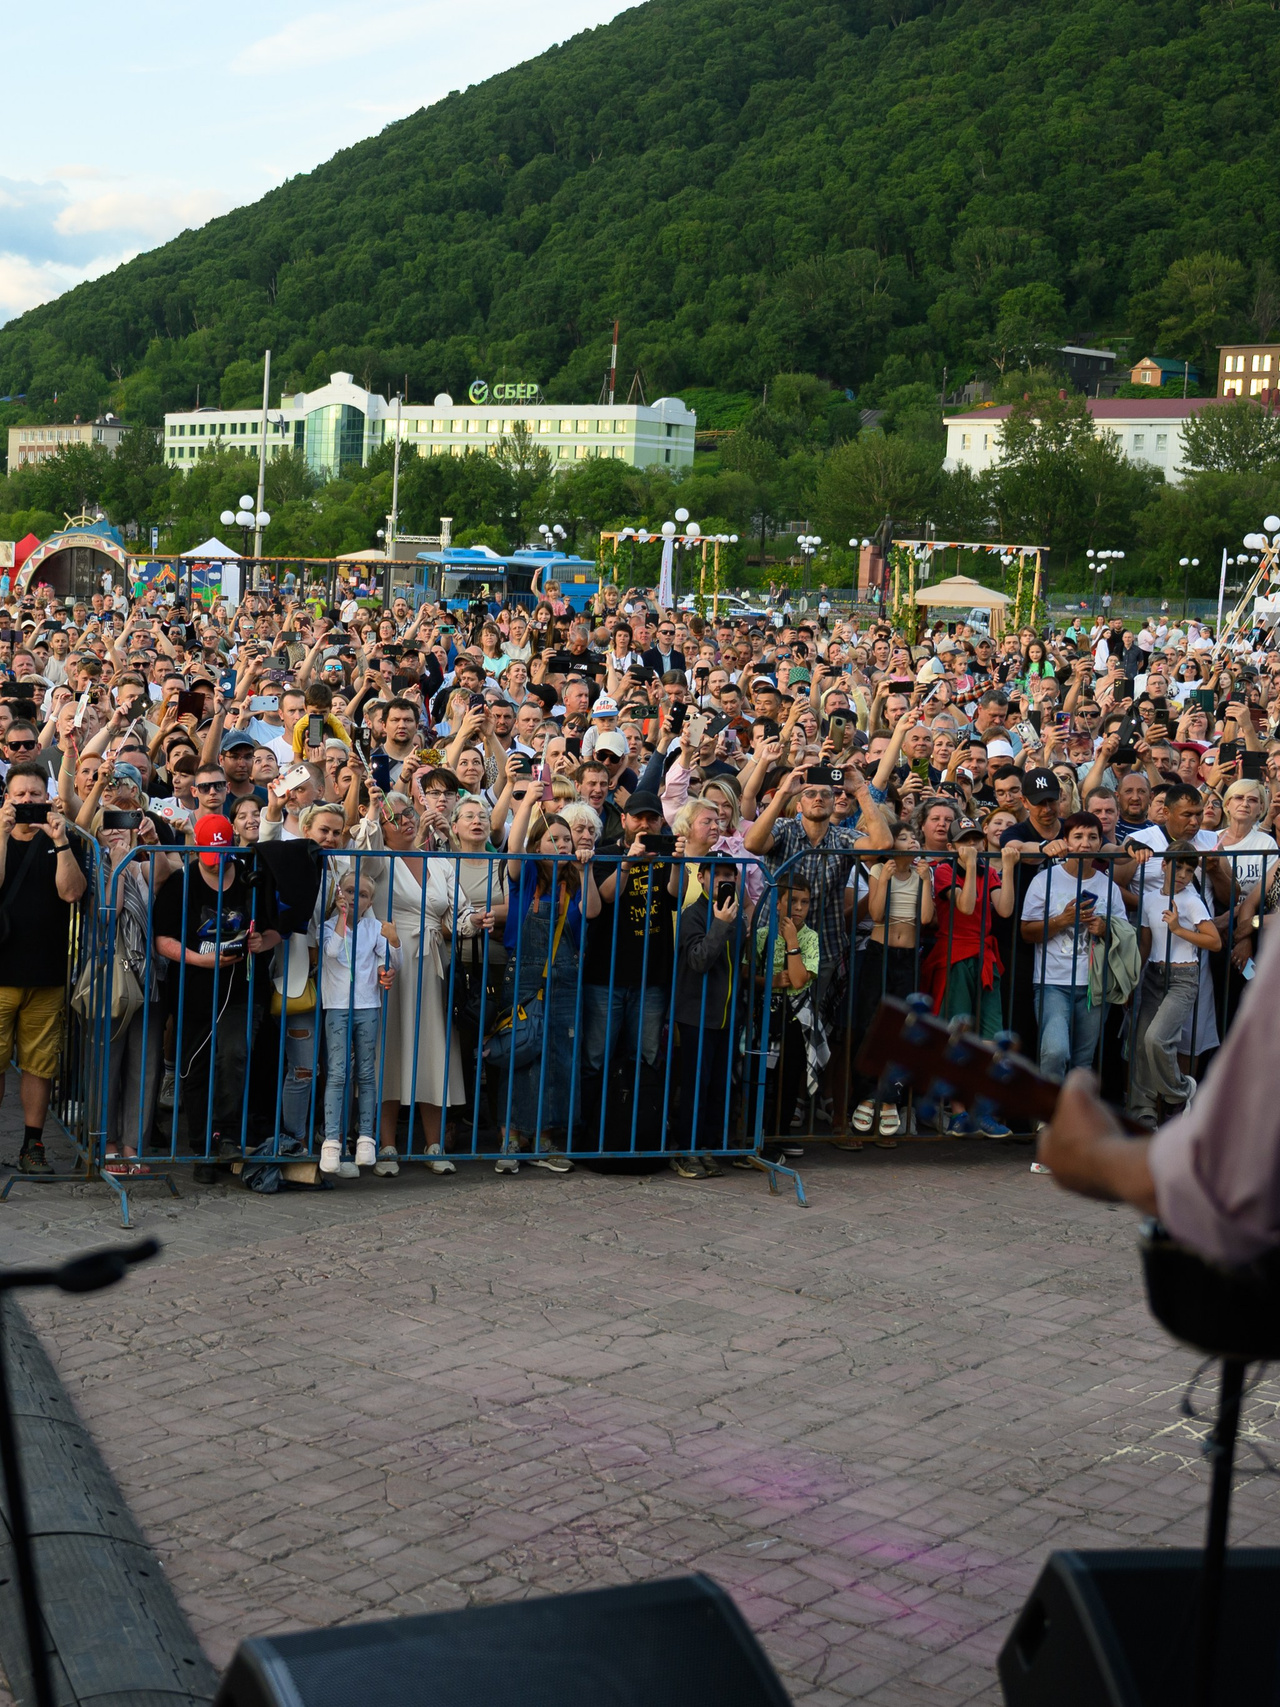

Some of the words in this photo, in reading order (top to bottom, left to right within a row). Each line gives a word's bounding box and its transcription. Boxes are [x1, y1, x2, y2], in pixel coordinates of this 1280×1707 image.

[493, 383, 538, 399] СБЕР
[213, 832, 223, 841] K
[635, 903, 658, 918] MAIC
